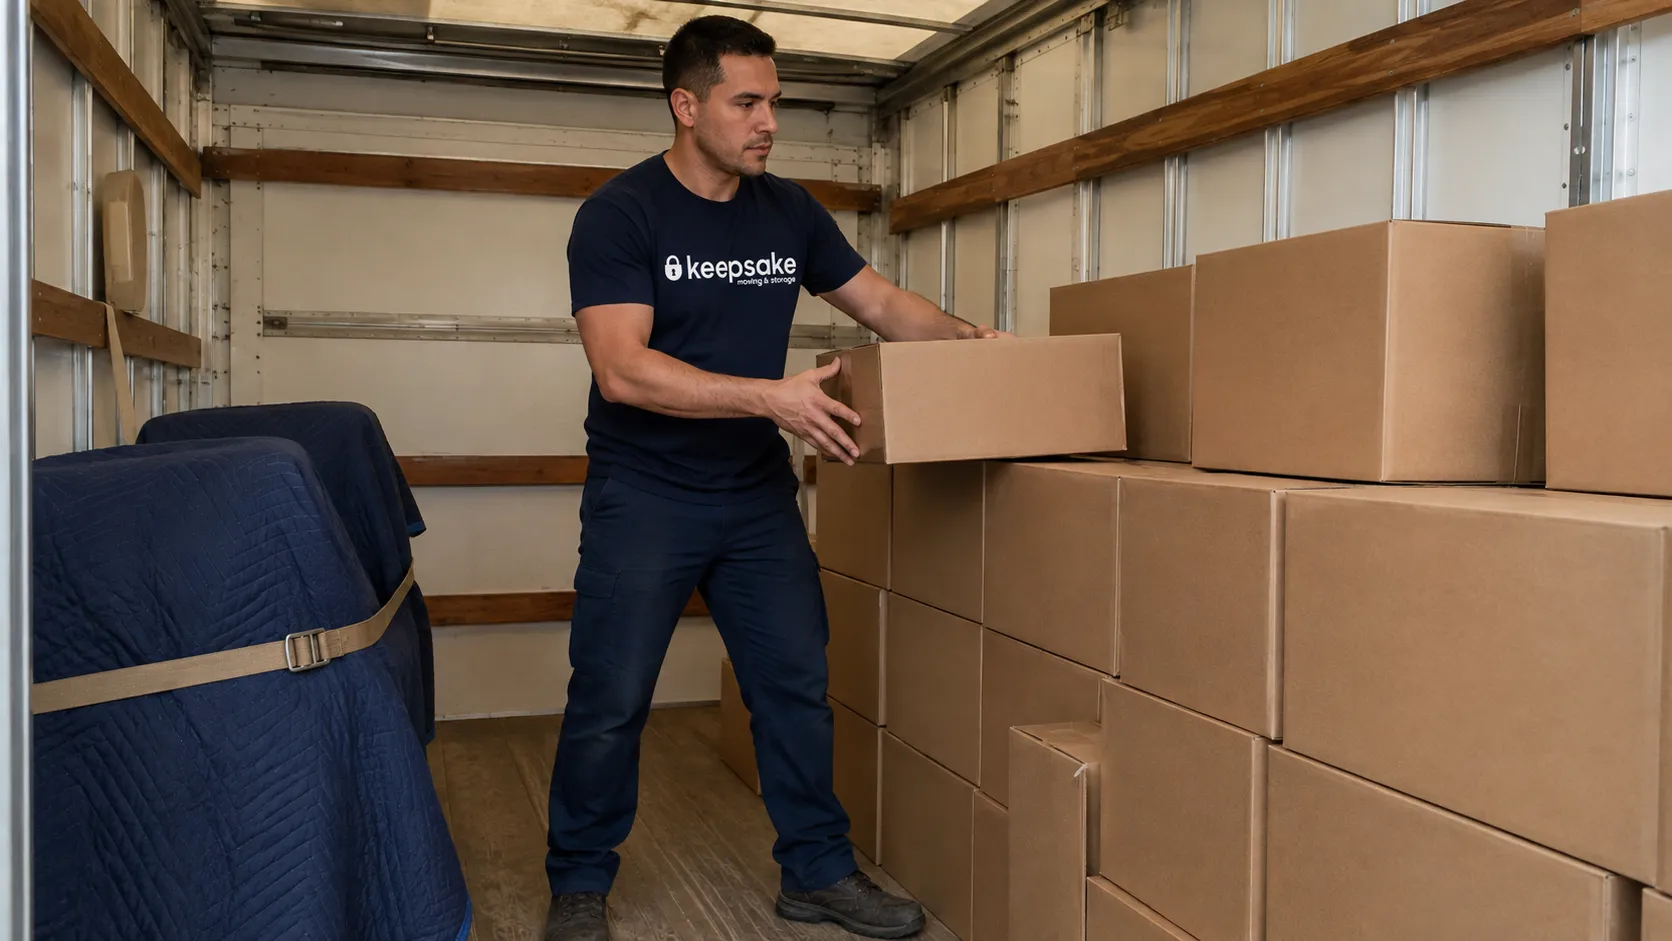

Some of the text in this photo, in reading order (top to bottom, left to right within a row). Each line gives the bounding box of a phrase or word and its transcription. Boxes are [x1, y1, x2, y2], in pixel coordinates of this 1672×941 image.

[686, 251, 797, 283] keepsake
[736, 276, 796, 287] moving & storage
